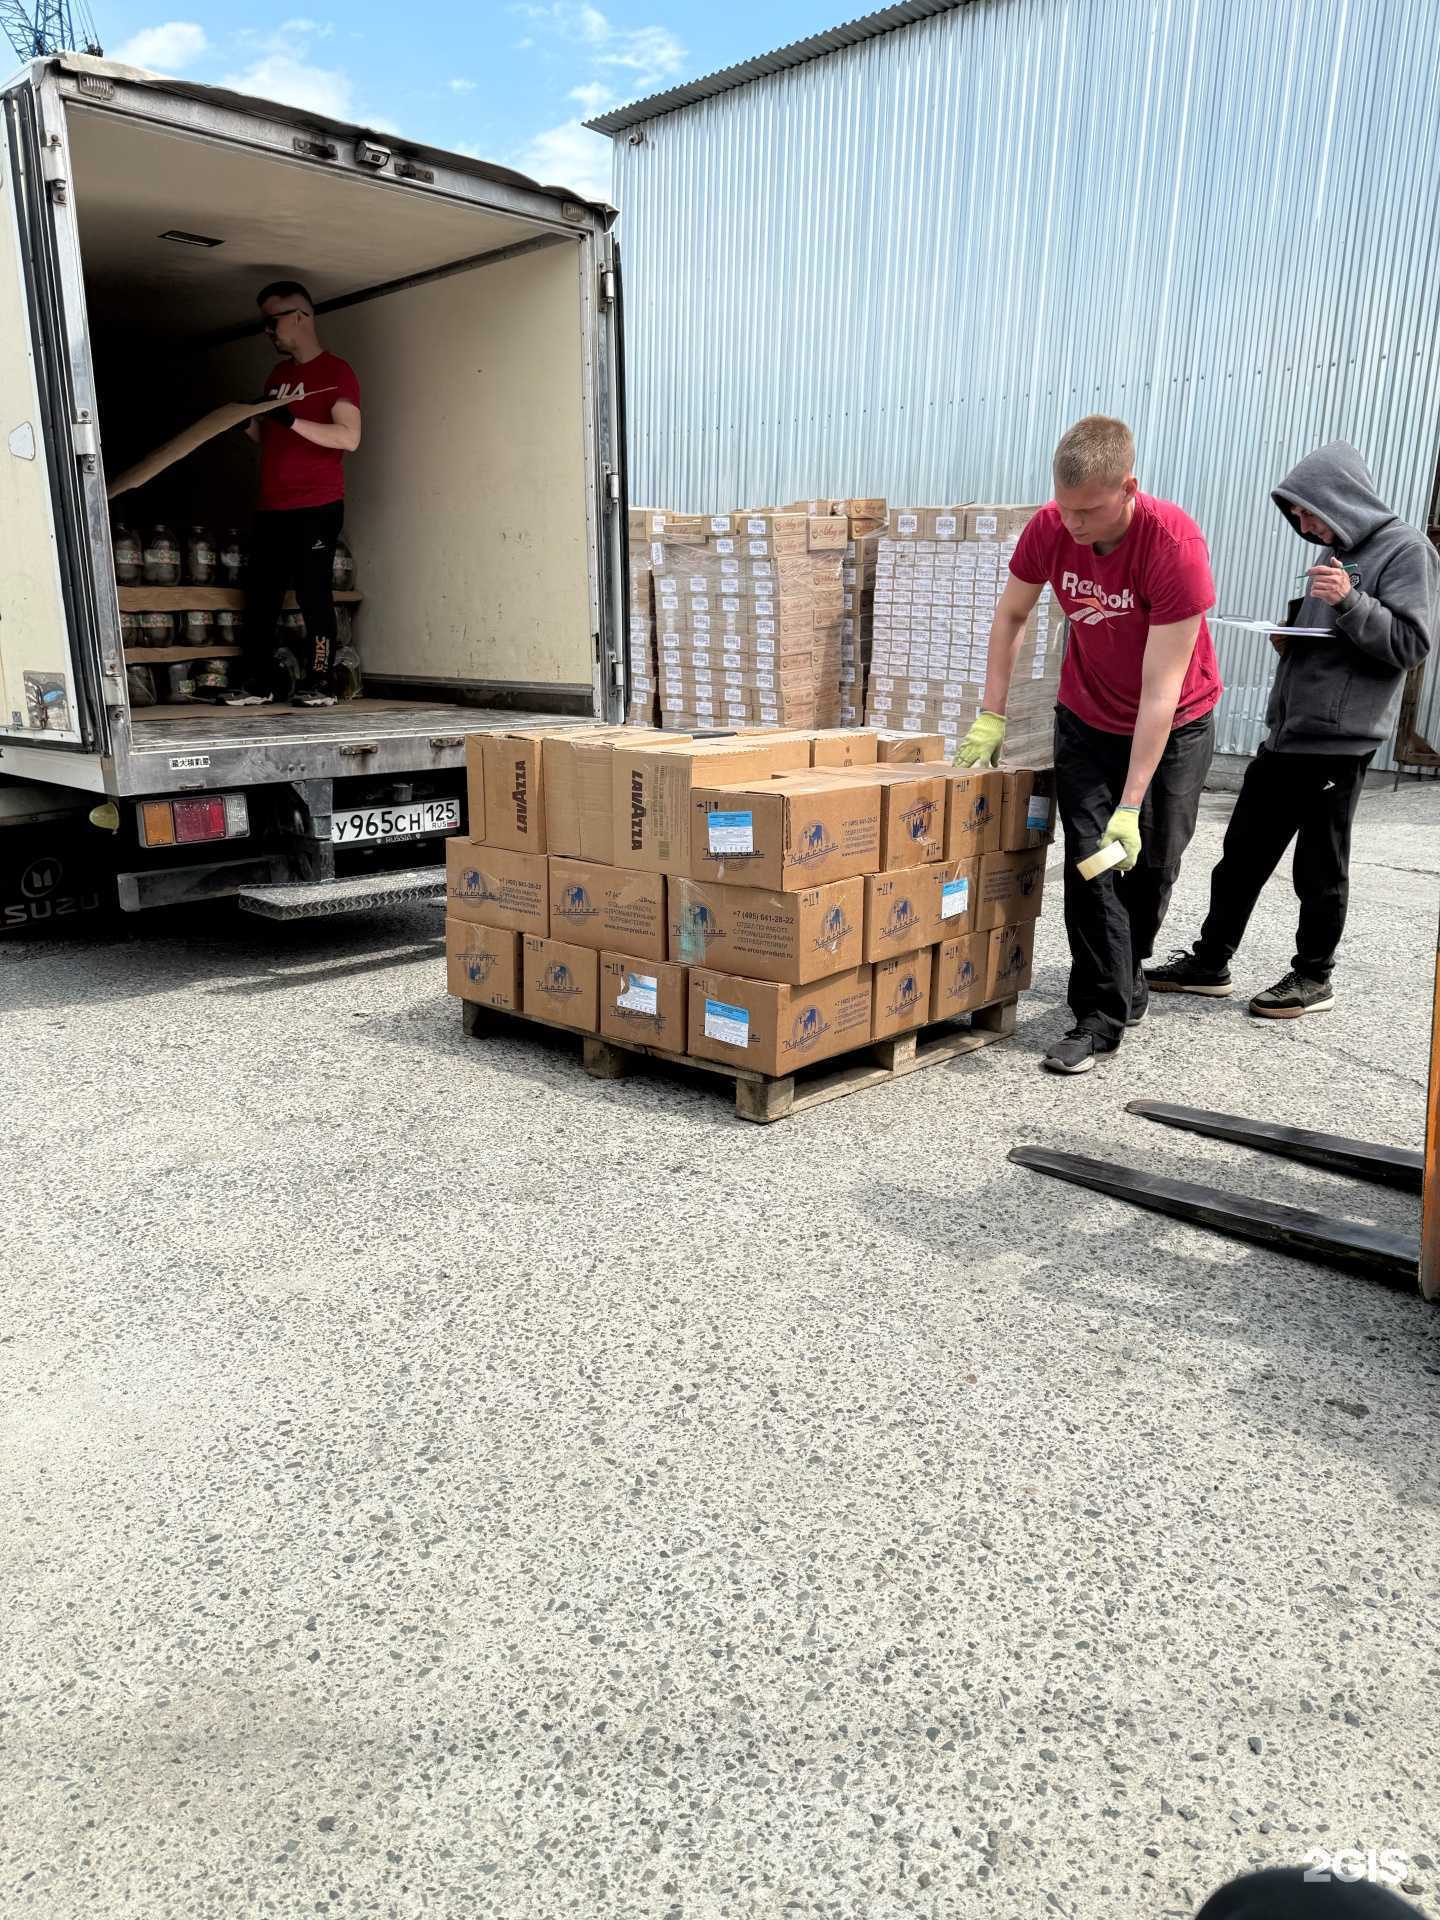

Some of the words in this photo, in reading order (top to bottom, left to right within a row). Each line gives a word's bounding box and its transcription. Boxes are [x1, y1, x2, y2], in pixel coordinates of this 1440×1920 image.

[512, 760, 528, 834] LAVAZZA
[426, 802, 455, 823] 125
[631, 769, 647, 850] LAVAZZA
[432, 820, 447, 829] RUS
[385, 832, 412, 844] RUSSIA
